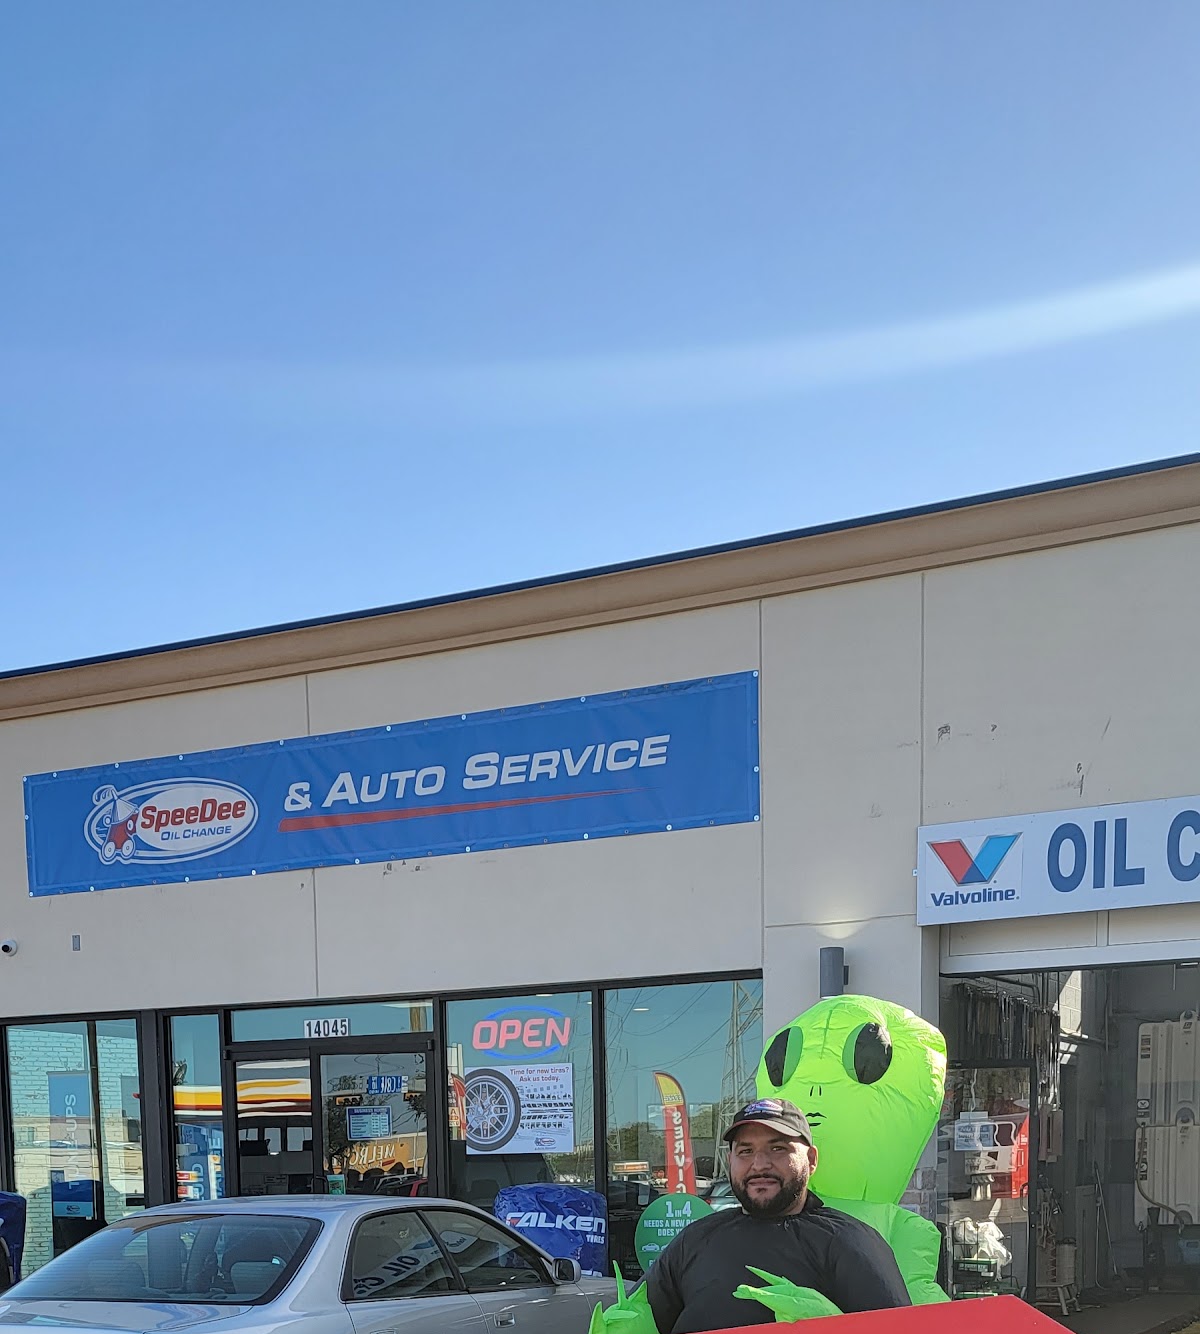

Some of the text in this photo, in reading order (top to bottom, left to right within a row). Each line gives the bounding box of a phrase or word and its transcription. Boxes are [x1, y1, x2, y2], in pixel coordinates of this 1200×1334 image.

[284, 734, 670, 811] & AUTO SERVICE
[141, 799, 246, 832] SpeeDee
[161, 826, 232, 841] OIL CHANGE
[1047, 818, 1145, 892] OIL
[931, 888, 1016, 907] Valvoline
[306, 1019, 347, 1037] 14045
[472, 1017, 571, 1050] OPEN
[526, 1067, 536, 1075] for
[666, 1201, 674, 1217] 1
[682, 1201, 692, 1217] 4
[506, 1212, 606, 1233] FALKEN
[644, 1219, 663, 1227] NEEDS
[665, 1219, 670, 1227] A
[586, 1234, 605, 1244] TIRES
[658, 1228, 675, 1236] DOES
